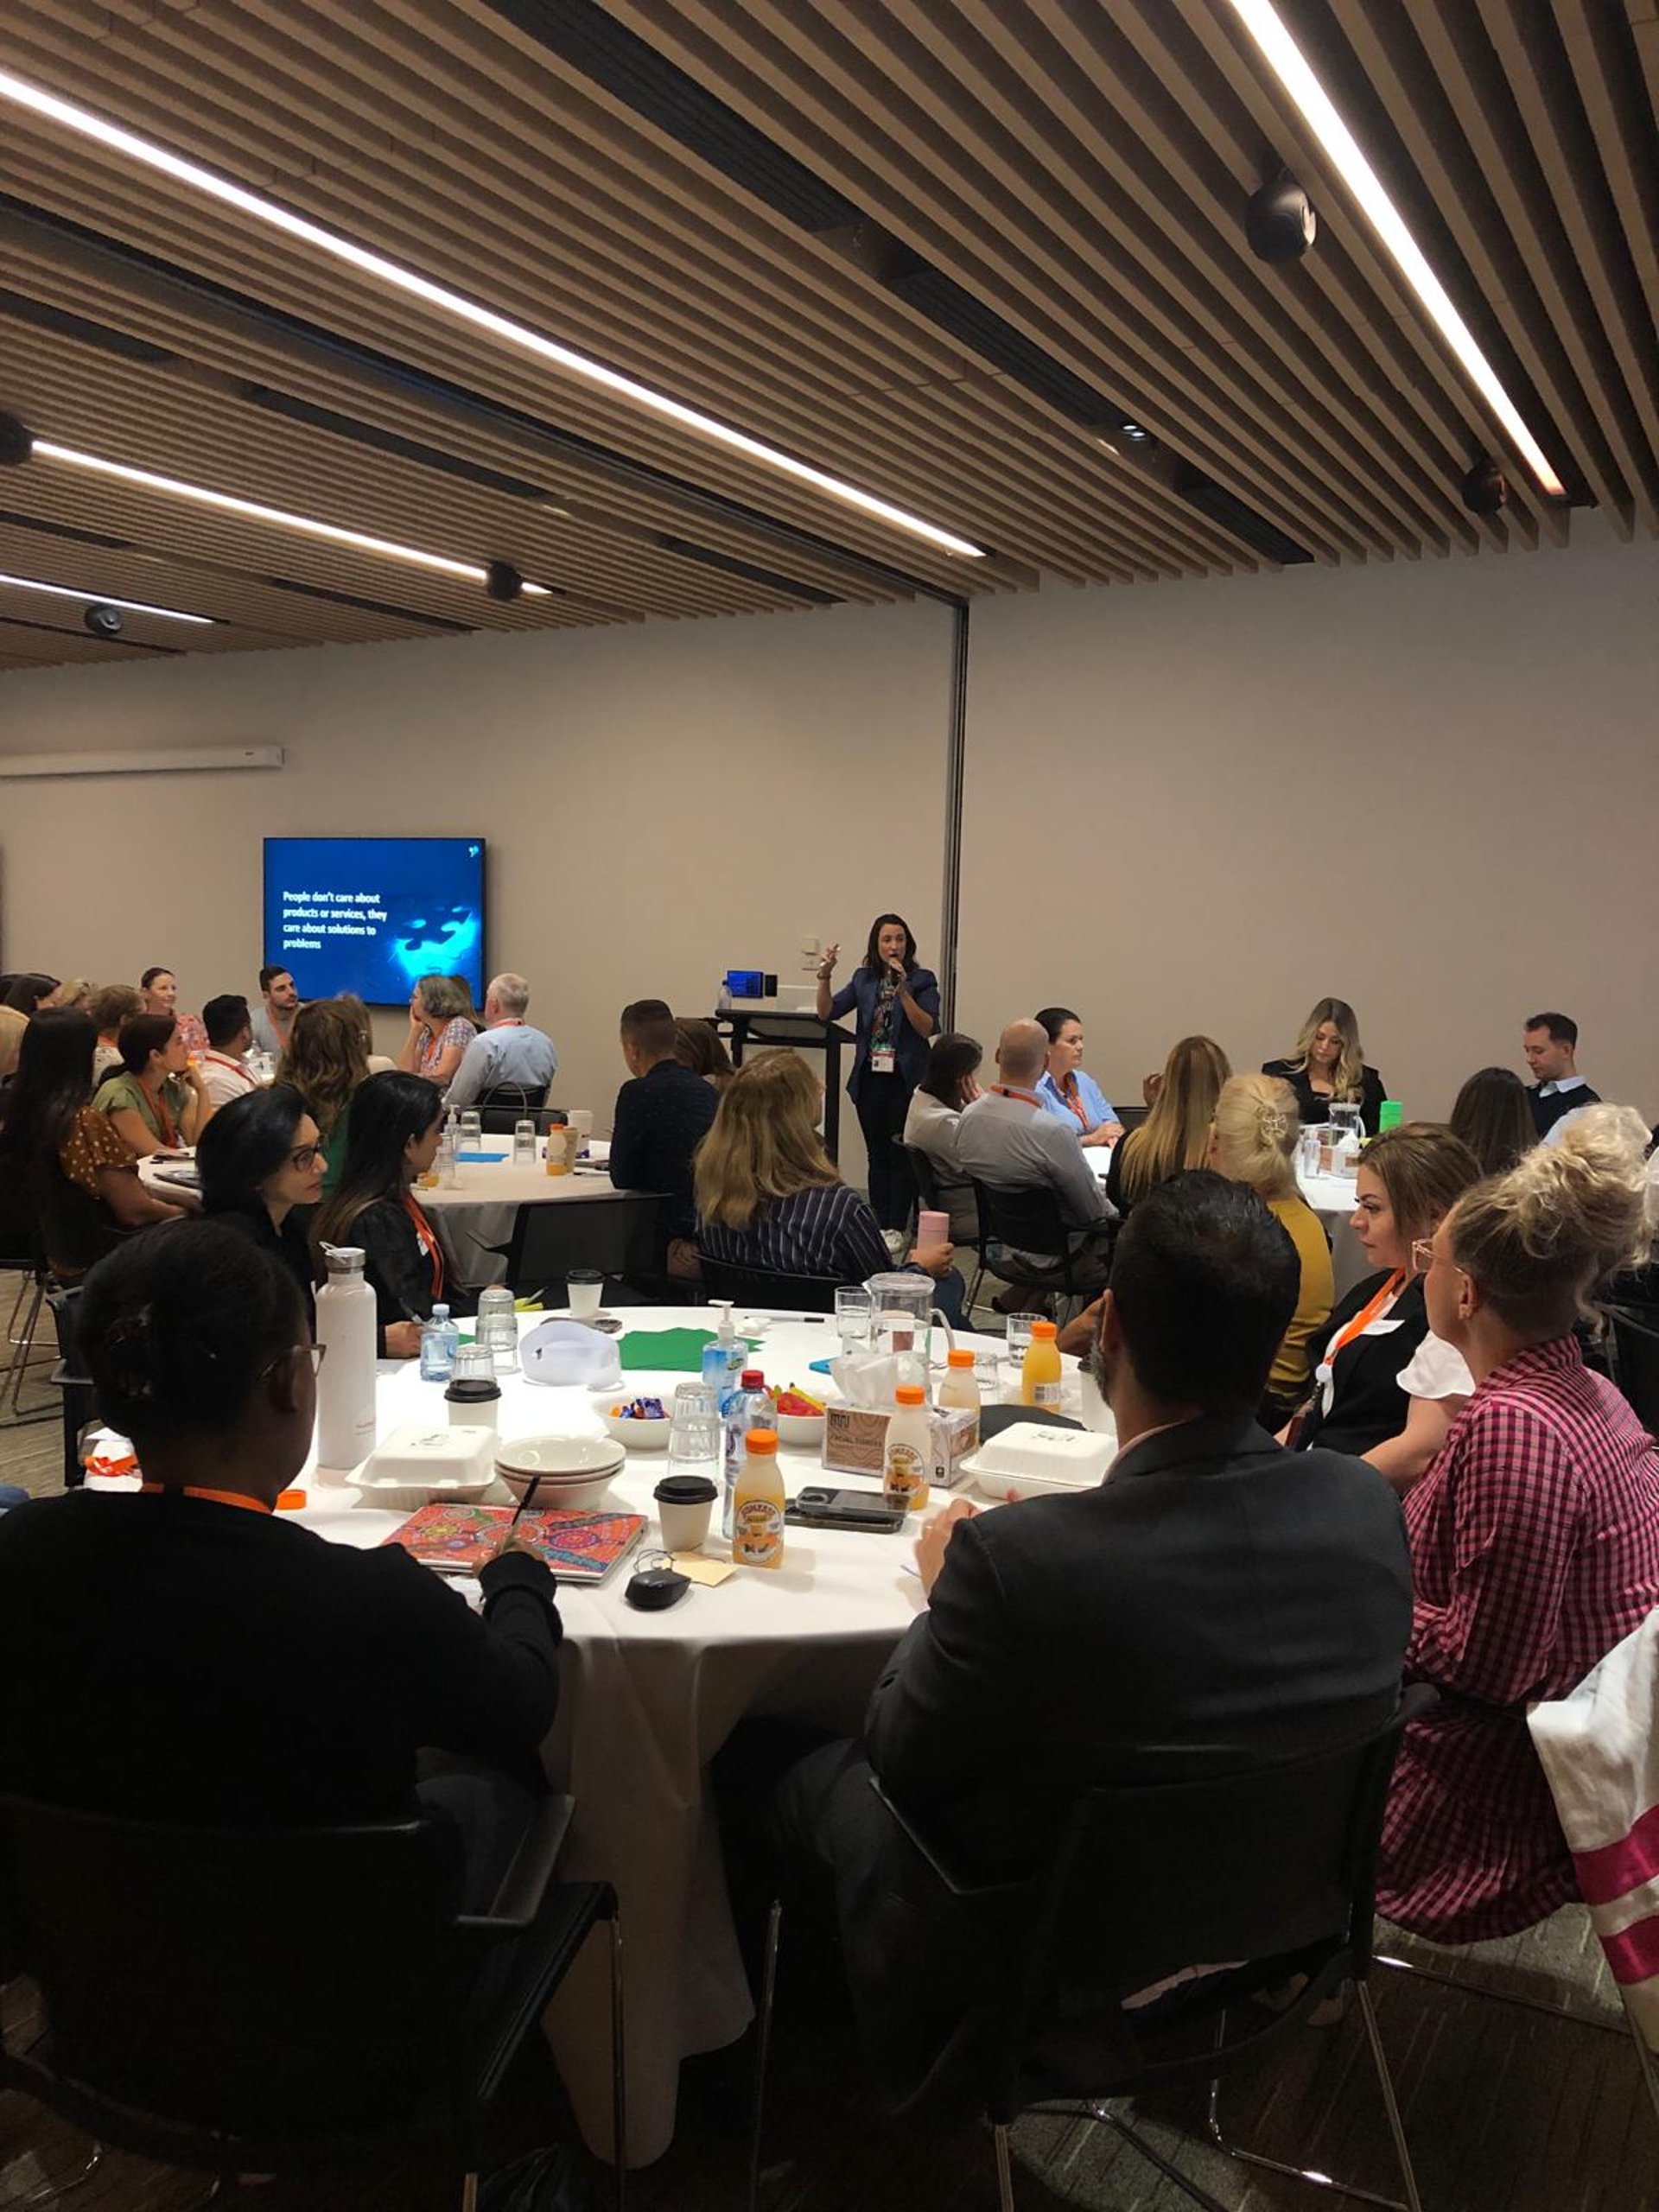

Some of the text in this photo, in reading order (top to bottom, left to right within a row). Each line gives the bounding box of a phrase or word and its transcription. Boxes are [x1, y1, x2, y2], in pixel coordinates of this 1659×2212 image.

[283, 892, 380, 904] People don't care about
[283, 906, 319, 918] products
[330, 908, 366, 921] services,
[367, 909, 387, 922] they
[302, 923, 327, 933] about
[327, 924, 365, 935] solutions
[366, 926, 377, 936] to
[283, 938, 321, 950] problems
